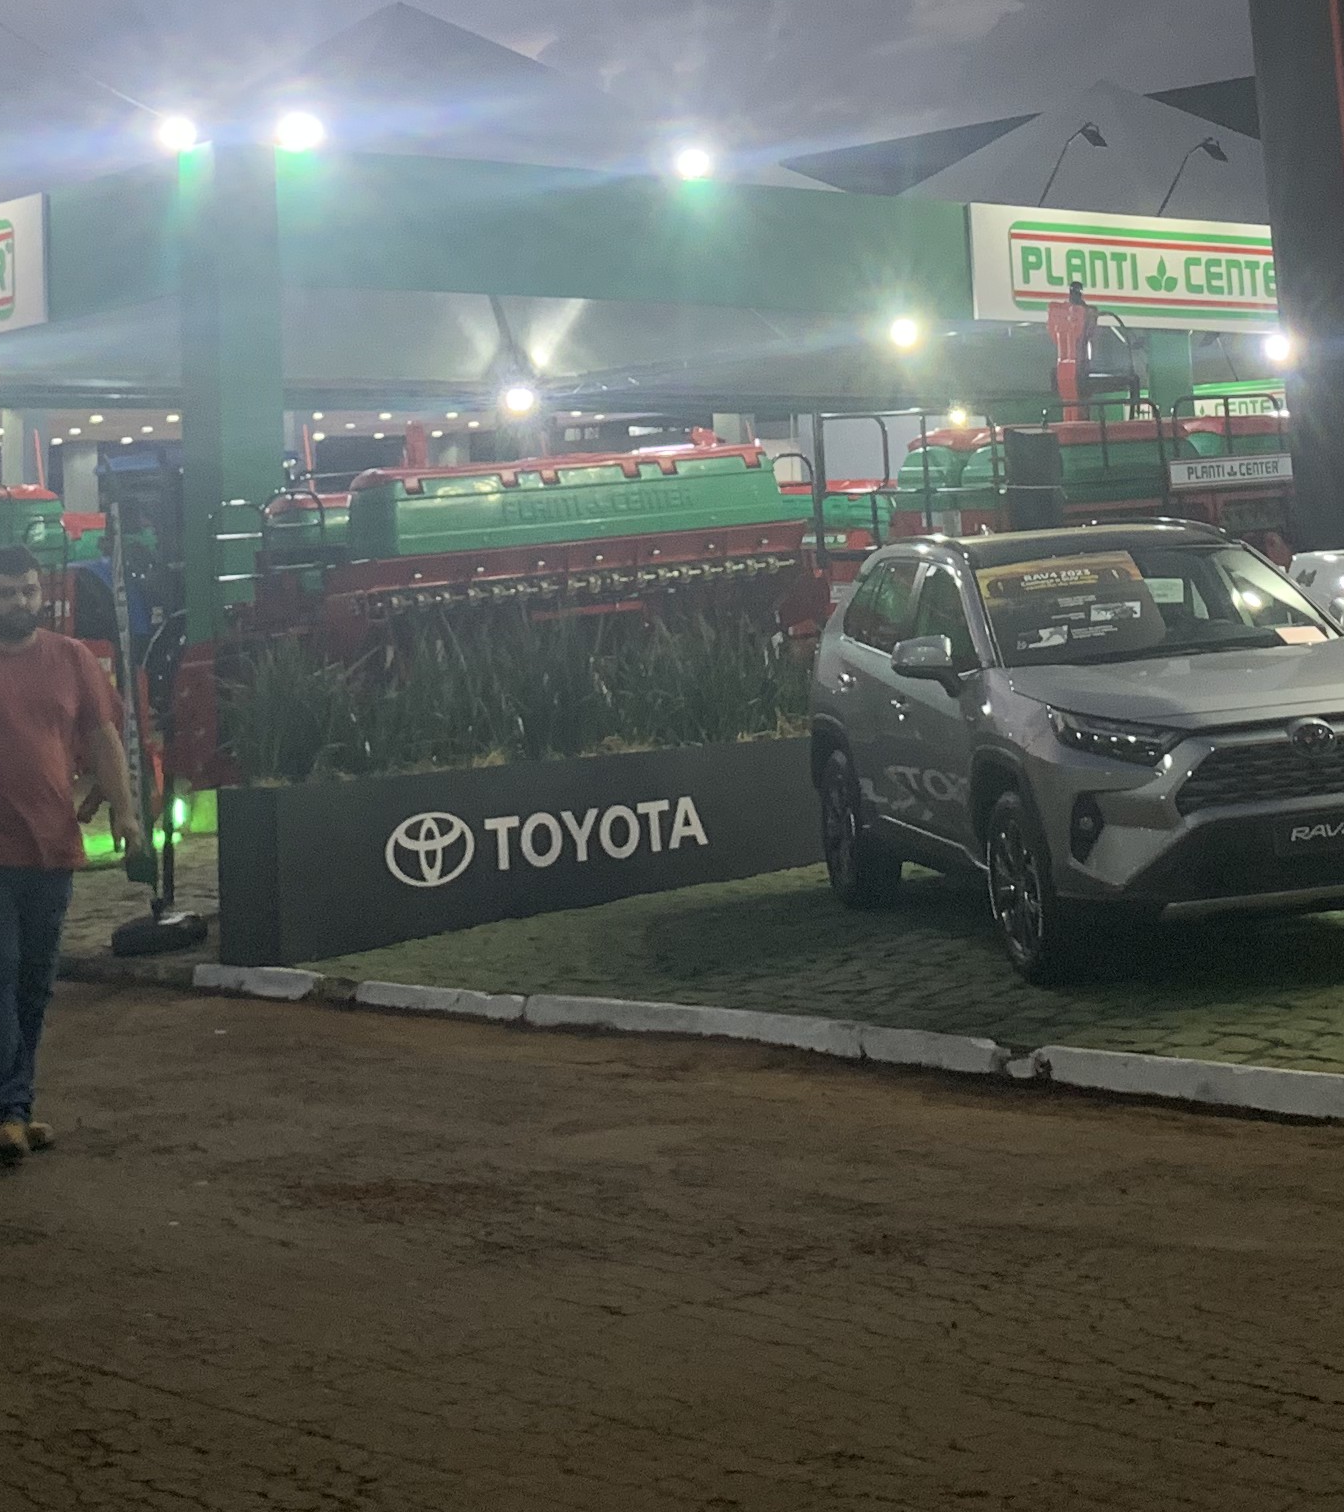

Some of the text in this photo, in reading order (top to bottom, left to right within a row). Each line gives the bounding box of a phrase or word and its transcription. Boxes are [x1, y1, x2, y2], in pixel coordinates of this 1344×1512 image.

[1020, 245, 1277, 298] PLANTI CENTE
[1187, 461, 1279, 480] PLANTI CENTER
[484, 796, 709, 871] TOYOTA
